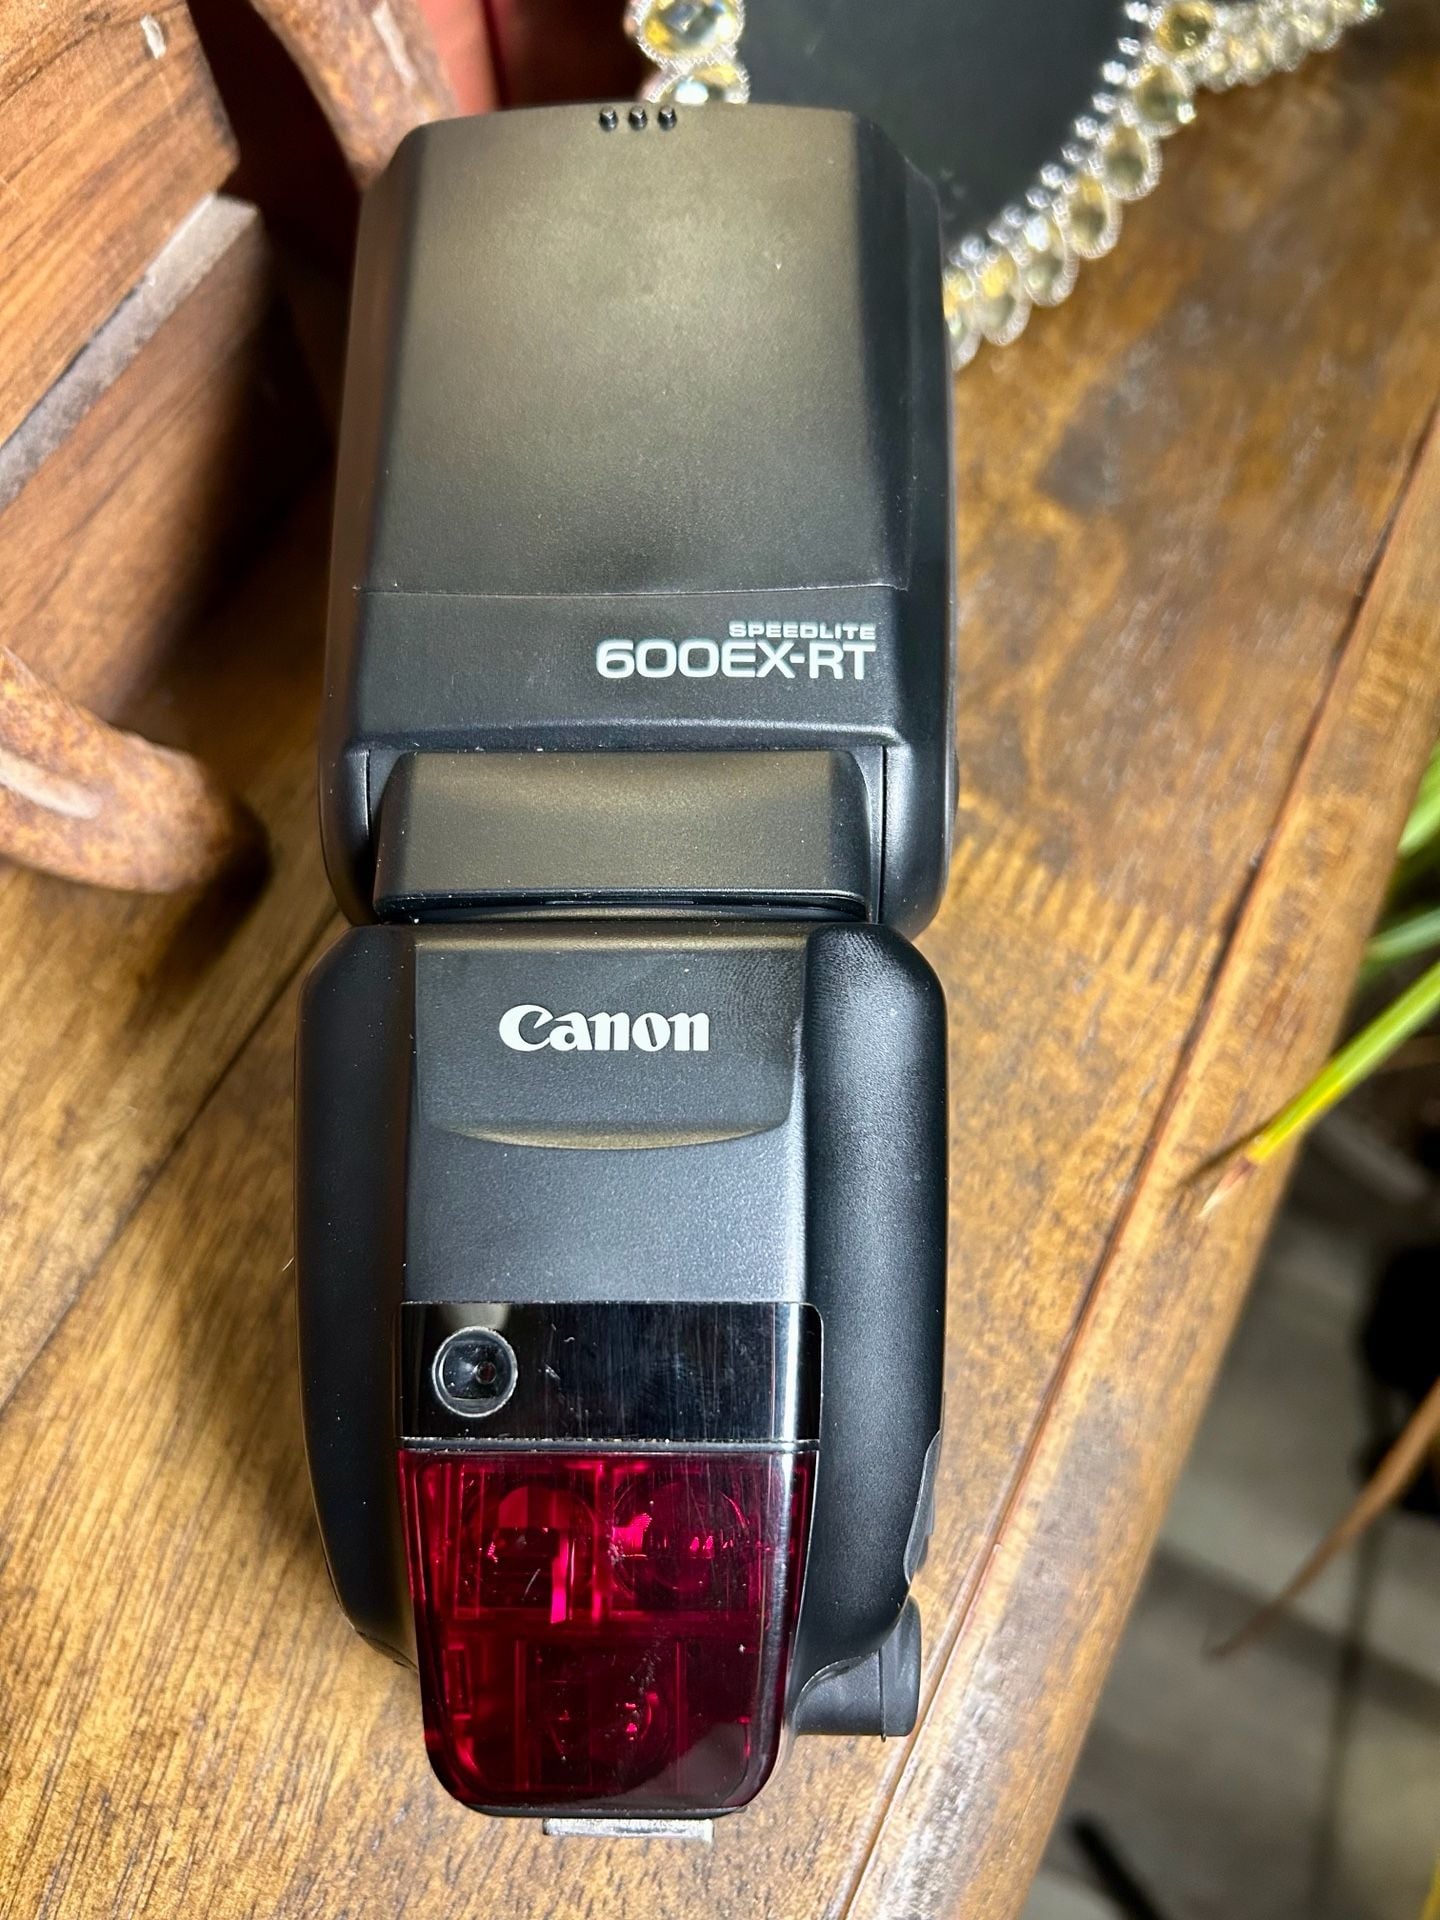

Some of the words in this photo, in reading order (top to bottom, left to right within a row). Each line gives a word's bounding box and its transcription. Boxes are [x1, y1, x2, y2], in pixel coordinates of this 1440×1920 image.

[728, 621, 877, 640] SPEEDLITE
[596, 639, 877, 680] 600EX-RT
[499, 1004, 710, 1051] Canon
